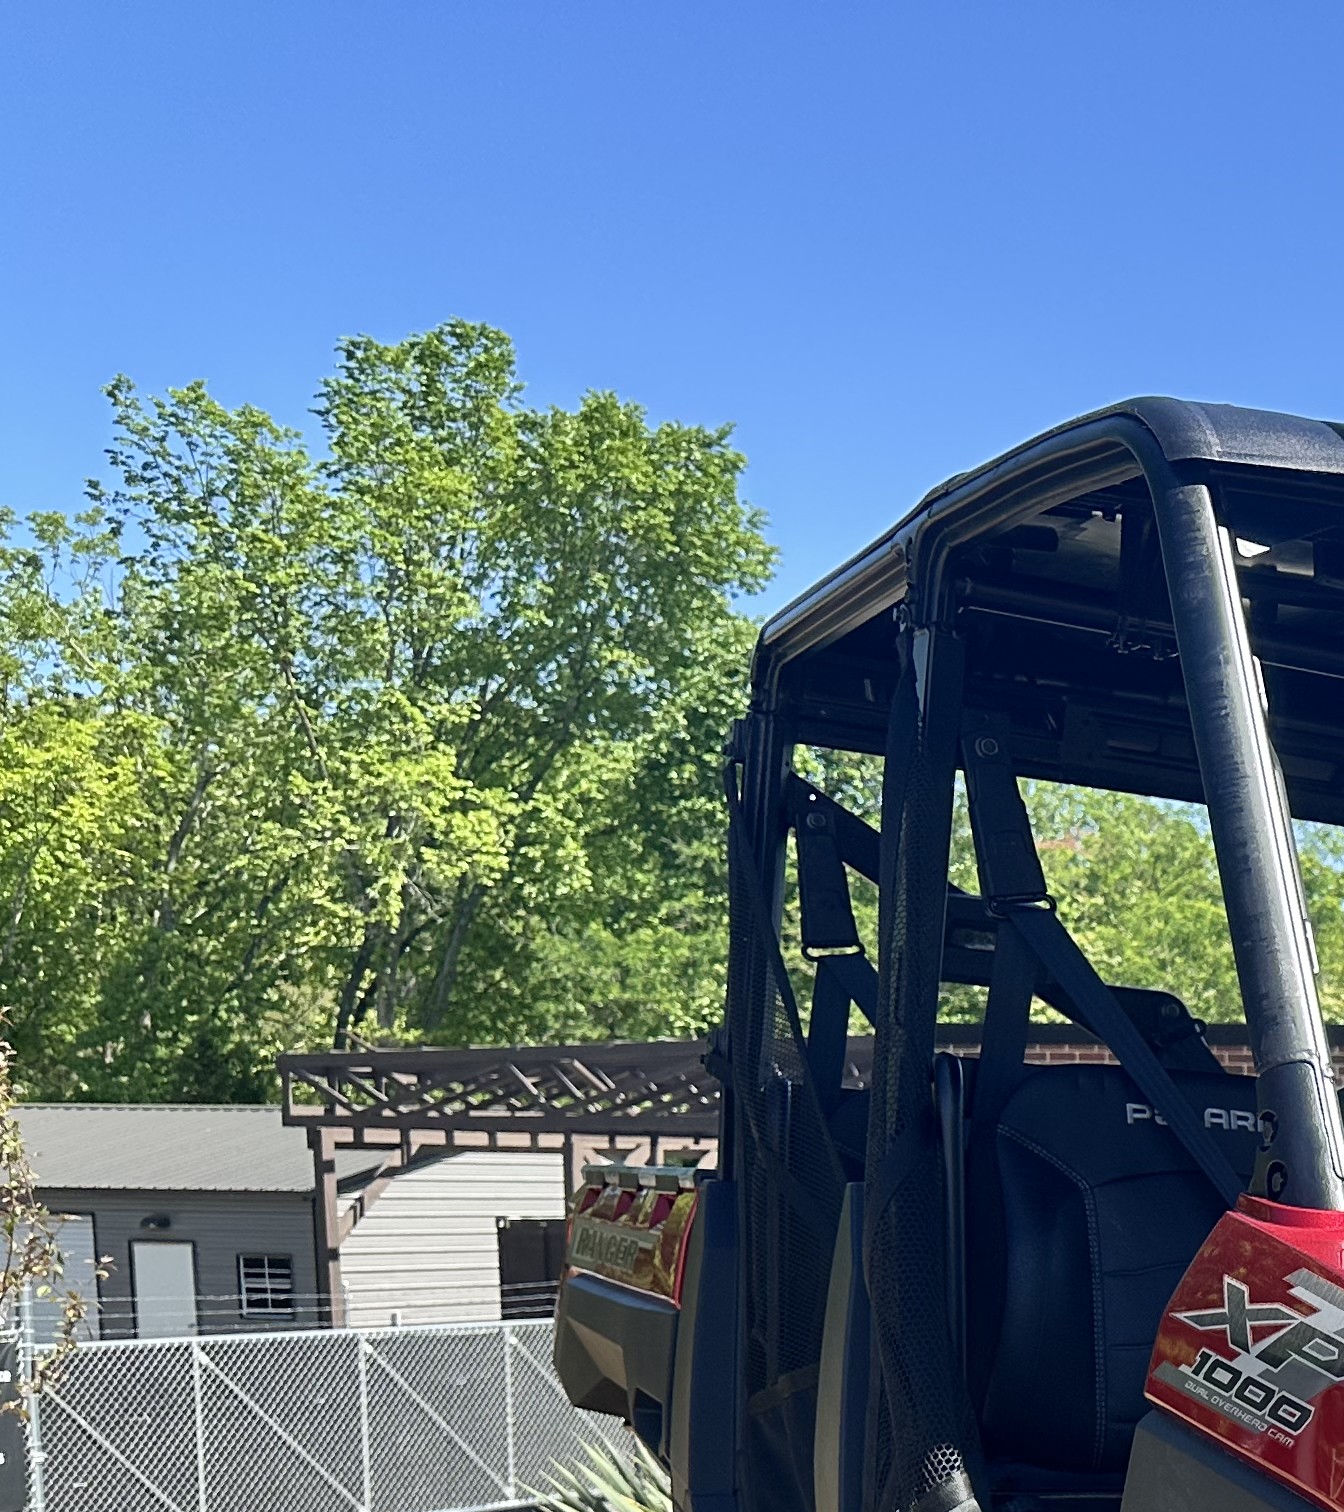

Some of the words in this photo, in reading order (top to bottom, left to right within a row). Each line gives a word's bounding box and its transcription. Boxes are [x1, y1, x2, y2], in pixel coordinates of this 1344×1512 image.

[1184, 1347, 1316, 1436] 1000
[1184, 1380, 1210, 1402] DUAL
[1210, 1395, 1269, 1433] OVERHEAD
[1267, 1427, 1295, 1448] CAM
